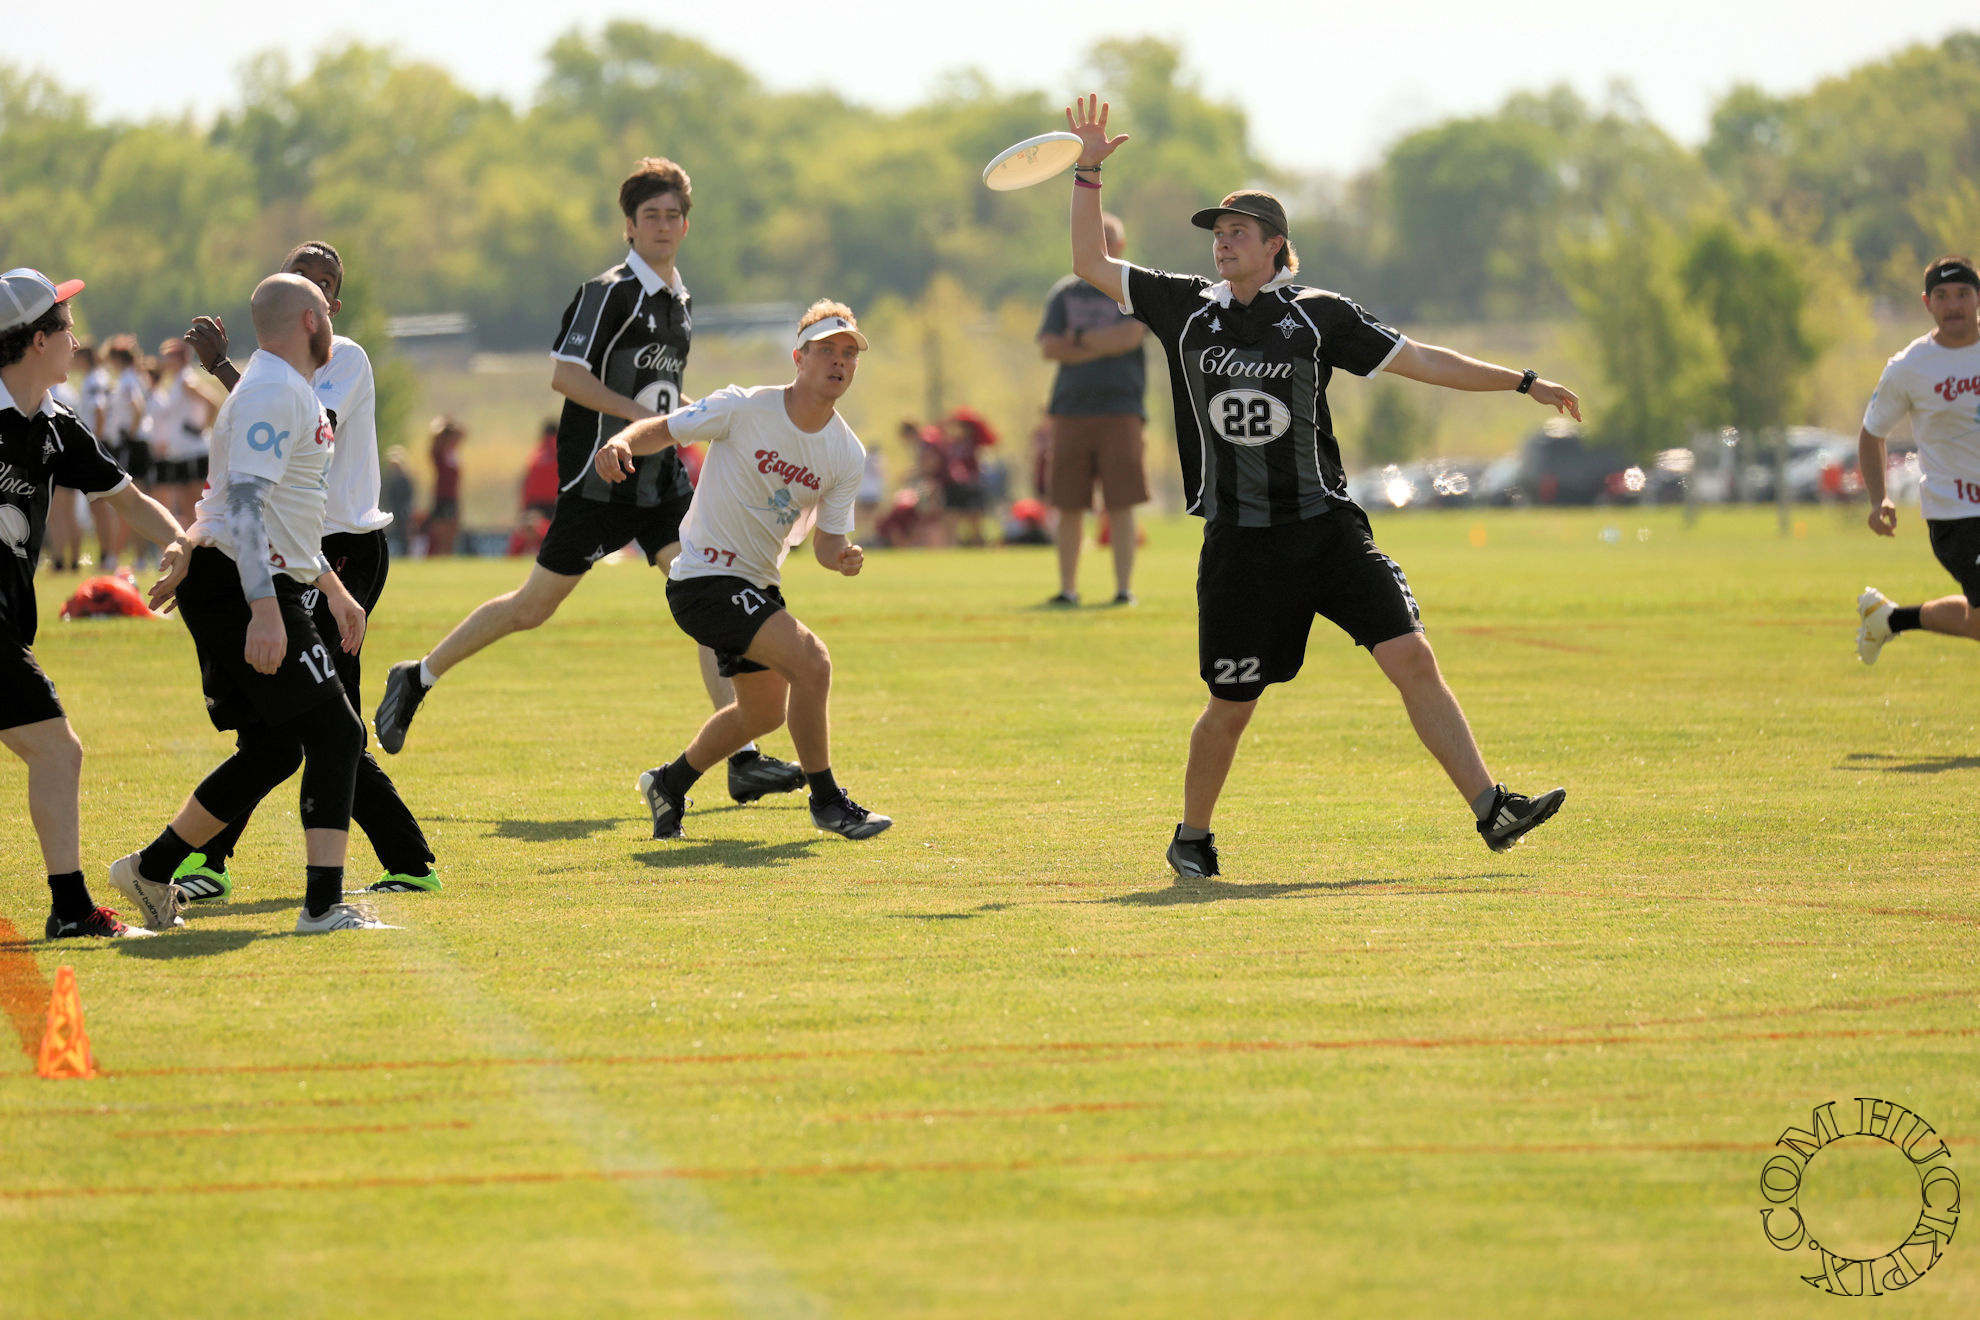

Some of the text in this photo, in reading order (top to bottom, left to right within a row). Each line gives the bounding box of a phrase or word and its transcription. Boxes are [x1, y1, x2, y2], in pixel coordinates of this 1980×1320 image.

[1199, 345, 1297, 379] Clown
[1222, 397, 1272, 438] 22
[754, 449, 822, 491] Eagles
[731, 588, 767, 615] 27
[299, 643, 336, 684] 12
[1213, 656, 1261, 684] 22
[132, 879, 145, 896] new
